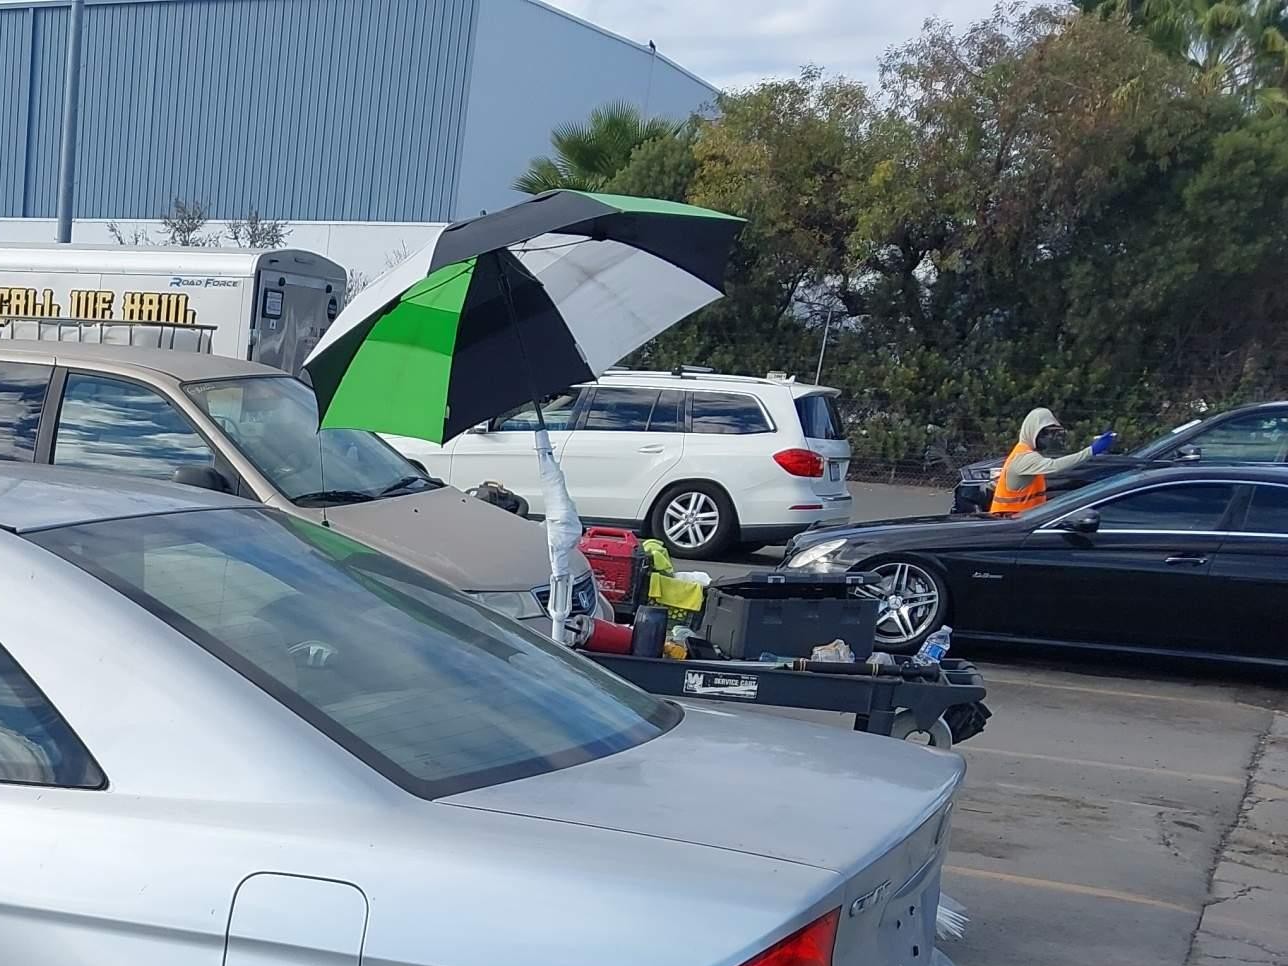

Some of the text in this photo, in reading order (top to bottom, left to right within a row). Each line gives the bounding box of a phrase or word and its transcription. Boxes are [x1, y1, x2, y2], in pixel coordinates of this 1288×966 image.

[122, 291, 197, 325] HAUL
[713, 677, 740, 686] SERVICE
[740, 679, 758, 688] CART
